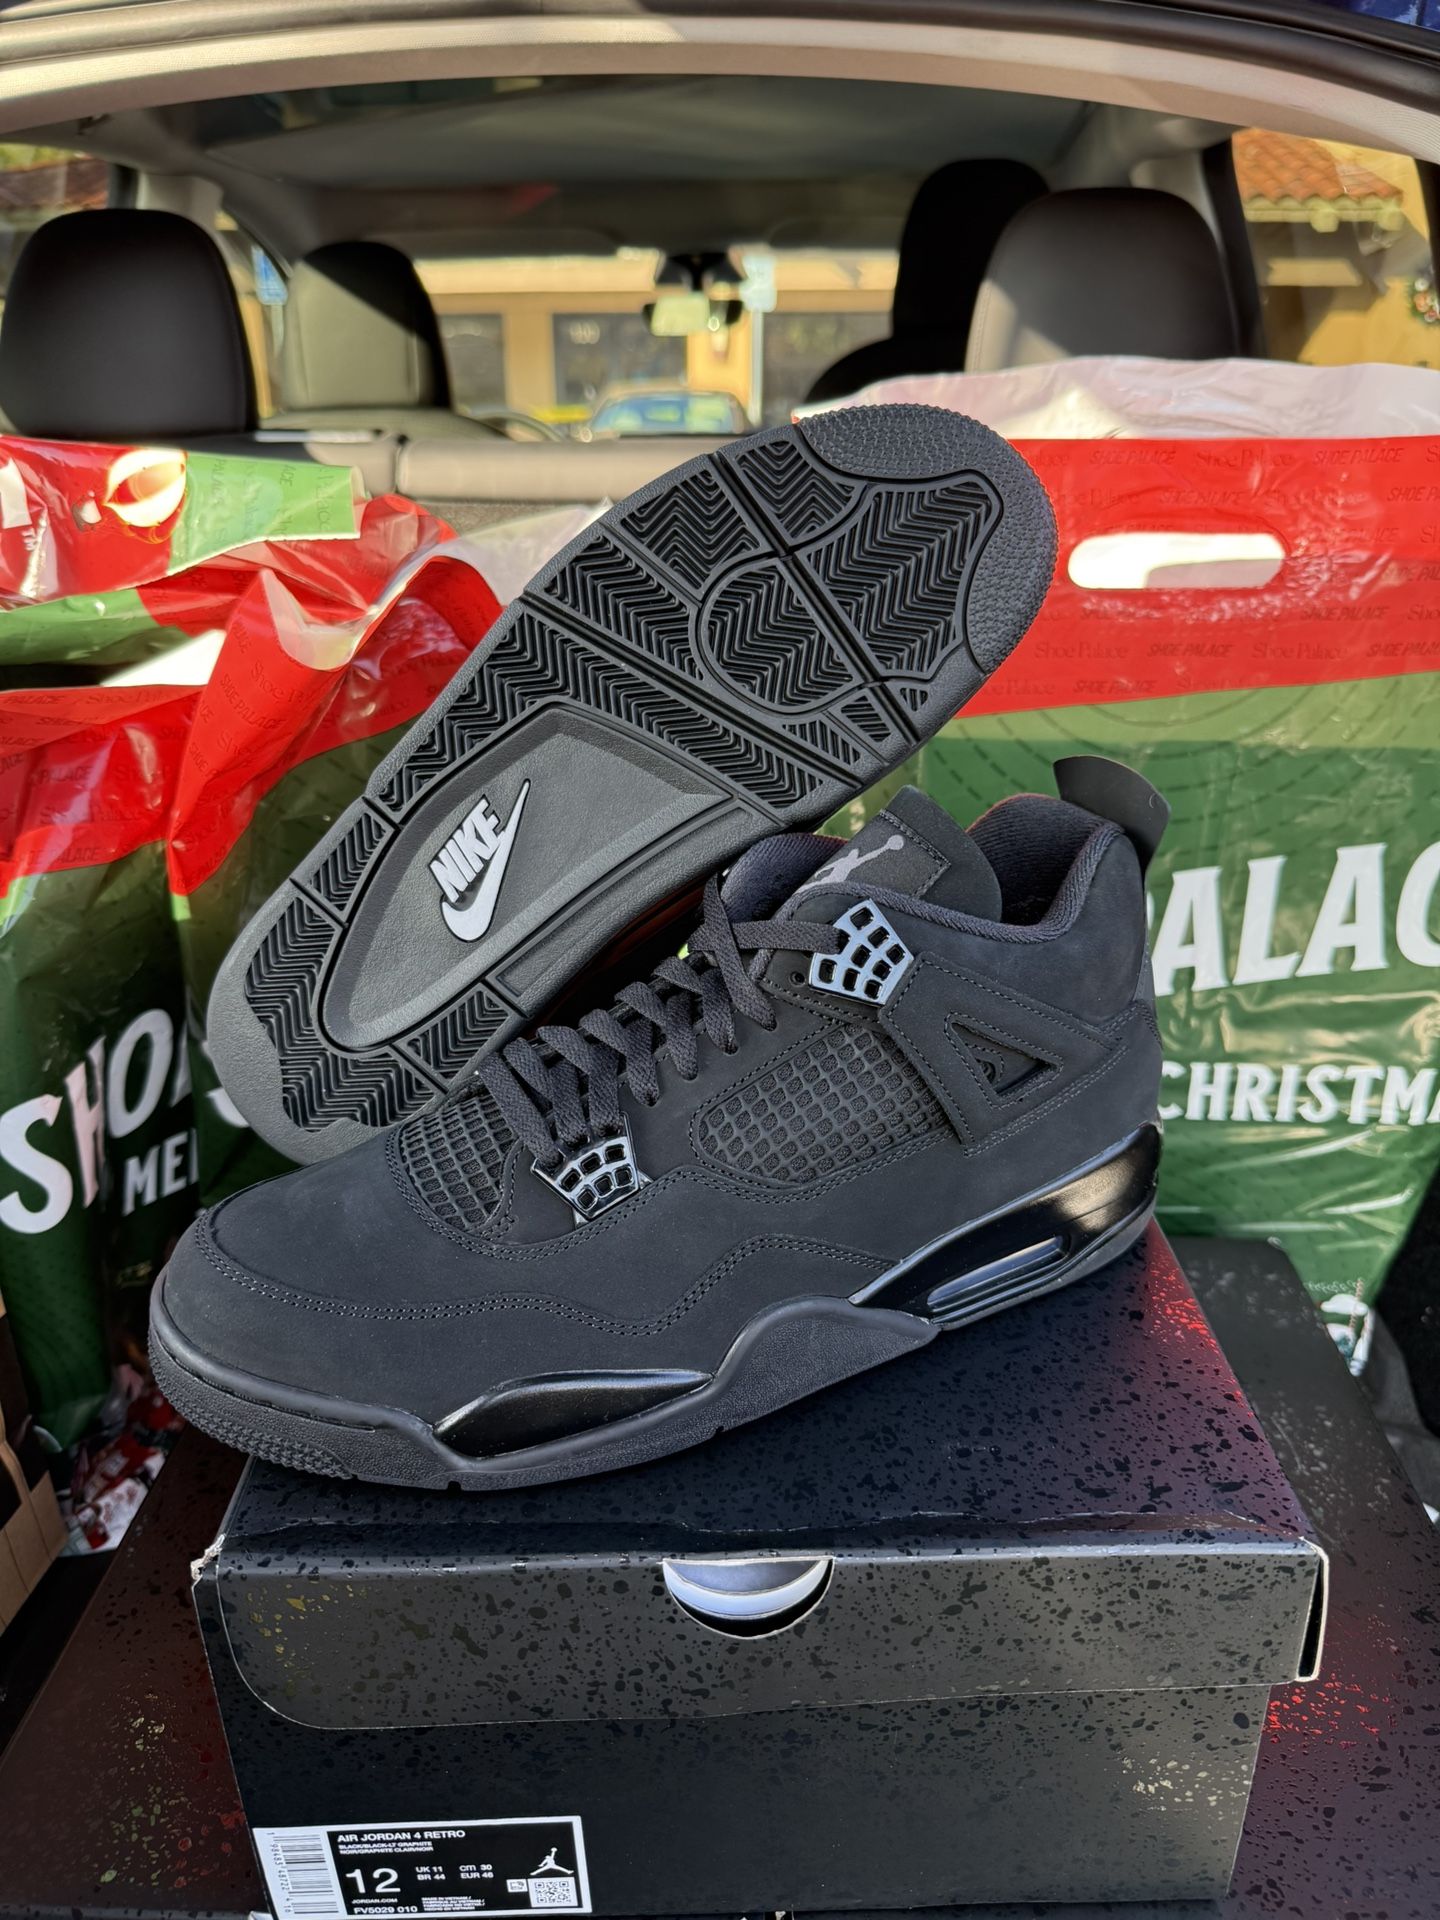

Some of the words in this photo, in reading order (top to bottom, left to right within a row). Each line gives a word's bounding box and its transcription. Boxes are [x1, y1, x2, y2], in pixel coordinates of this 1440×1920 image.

[429, 797, 503, 904] NIKE
[1146, 841, 1440, 998] ALAC
[0, 1008, 193, 1234] SHO
[337, 1834, 358, 1843] AIR
[361, 1832, 411, 1842] JORDAN
[424, 1830, 466, 1839] RETRO
[345, 1868, 401, 1894] 12
[354, 1907, 395, 1915] FV5029
